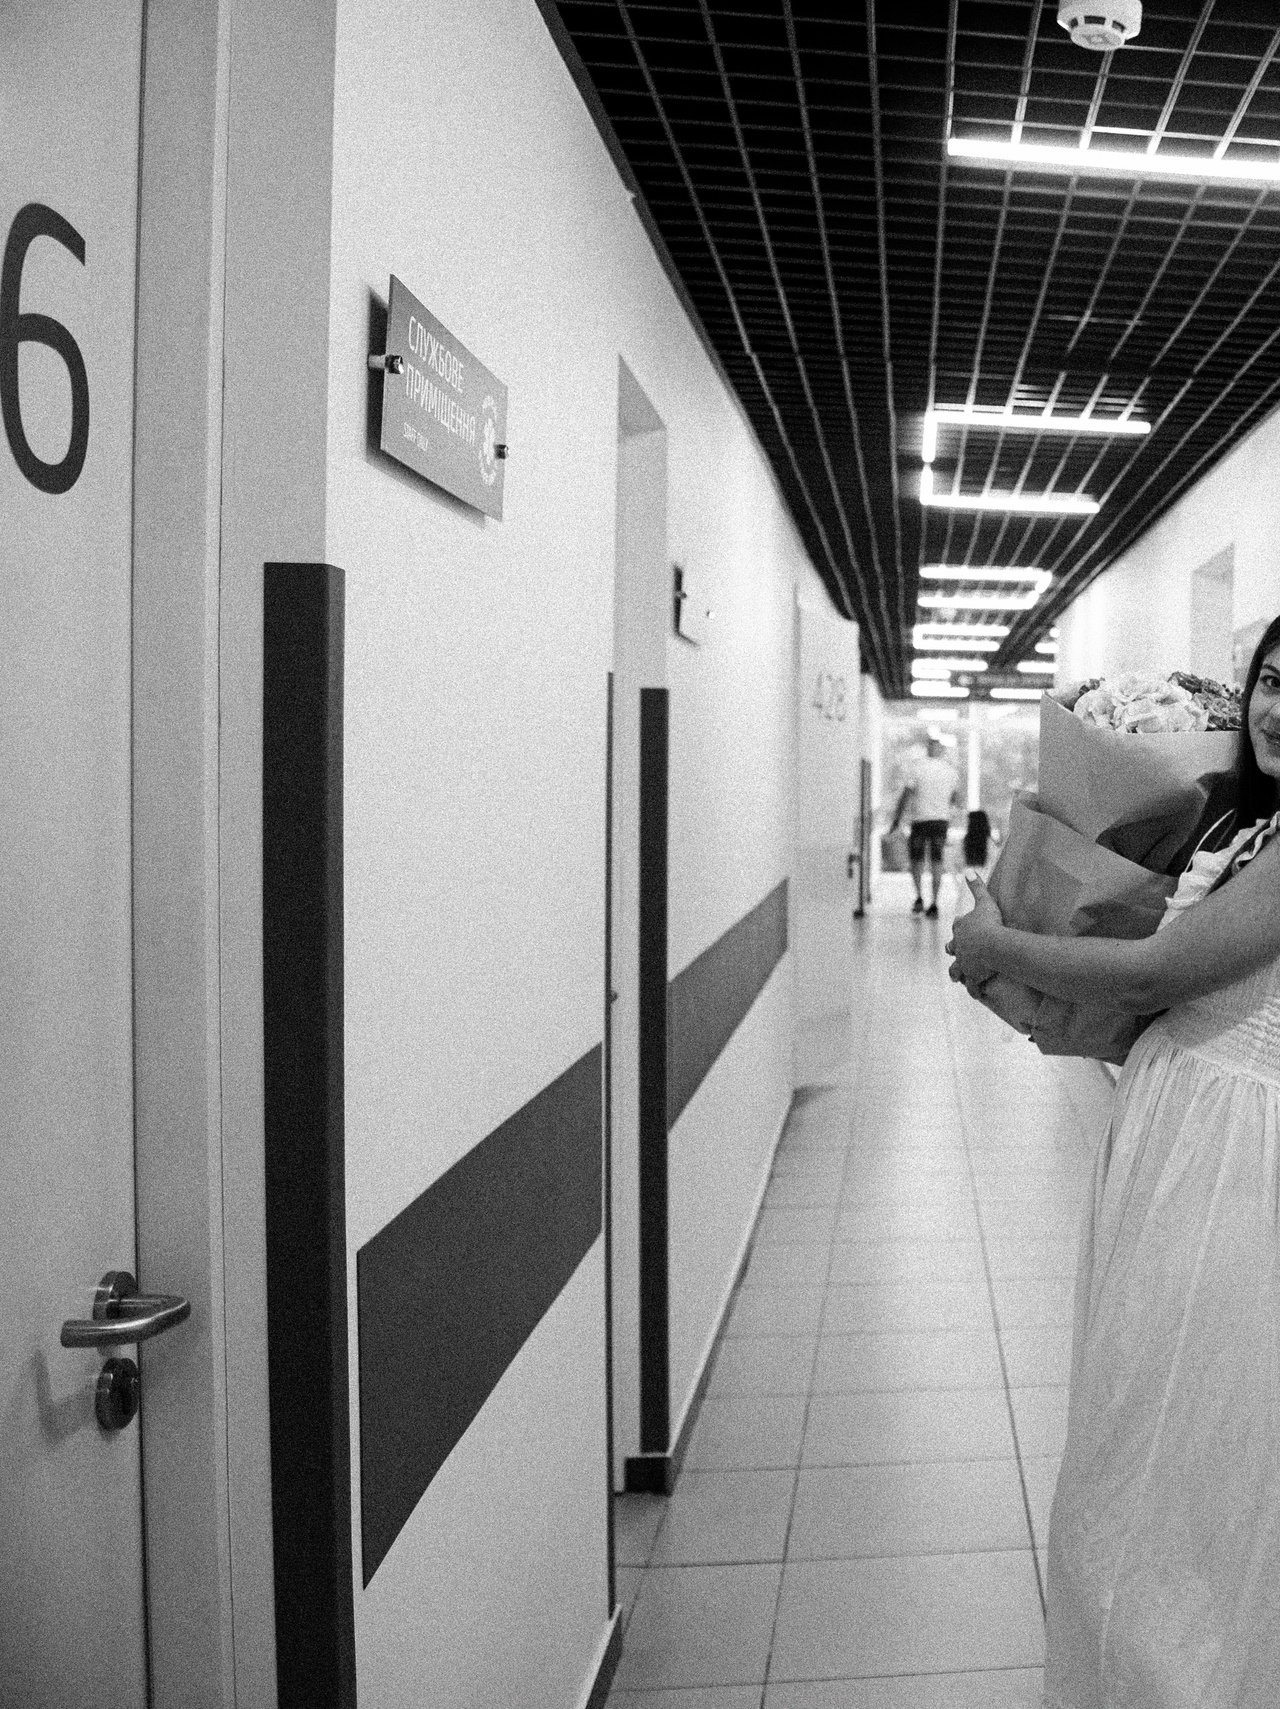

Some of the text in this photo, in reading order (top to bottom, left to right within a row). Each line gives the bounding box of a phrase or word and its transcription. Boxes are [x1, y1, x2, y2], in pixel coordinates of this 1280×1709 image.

[0, 203, 90, 495] 6
[409, 316, 464, 393] СЛУЖБОВЕ
[406, 363, 476, 446] ПРИМІЩЕННЯ
